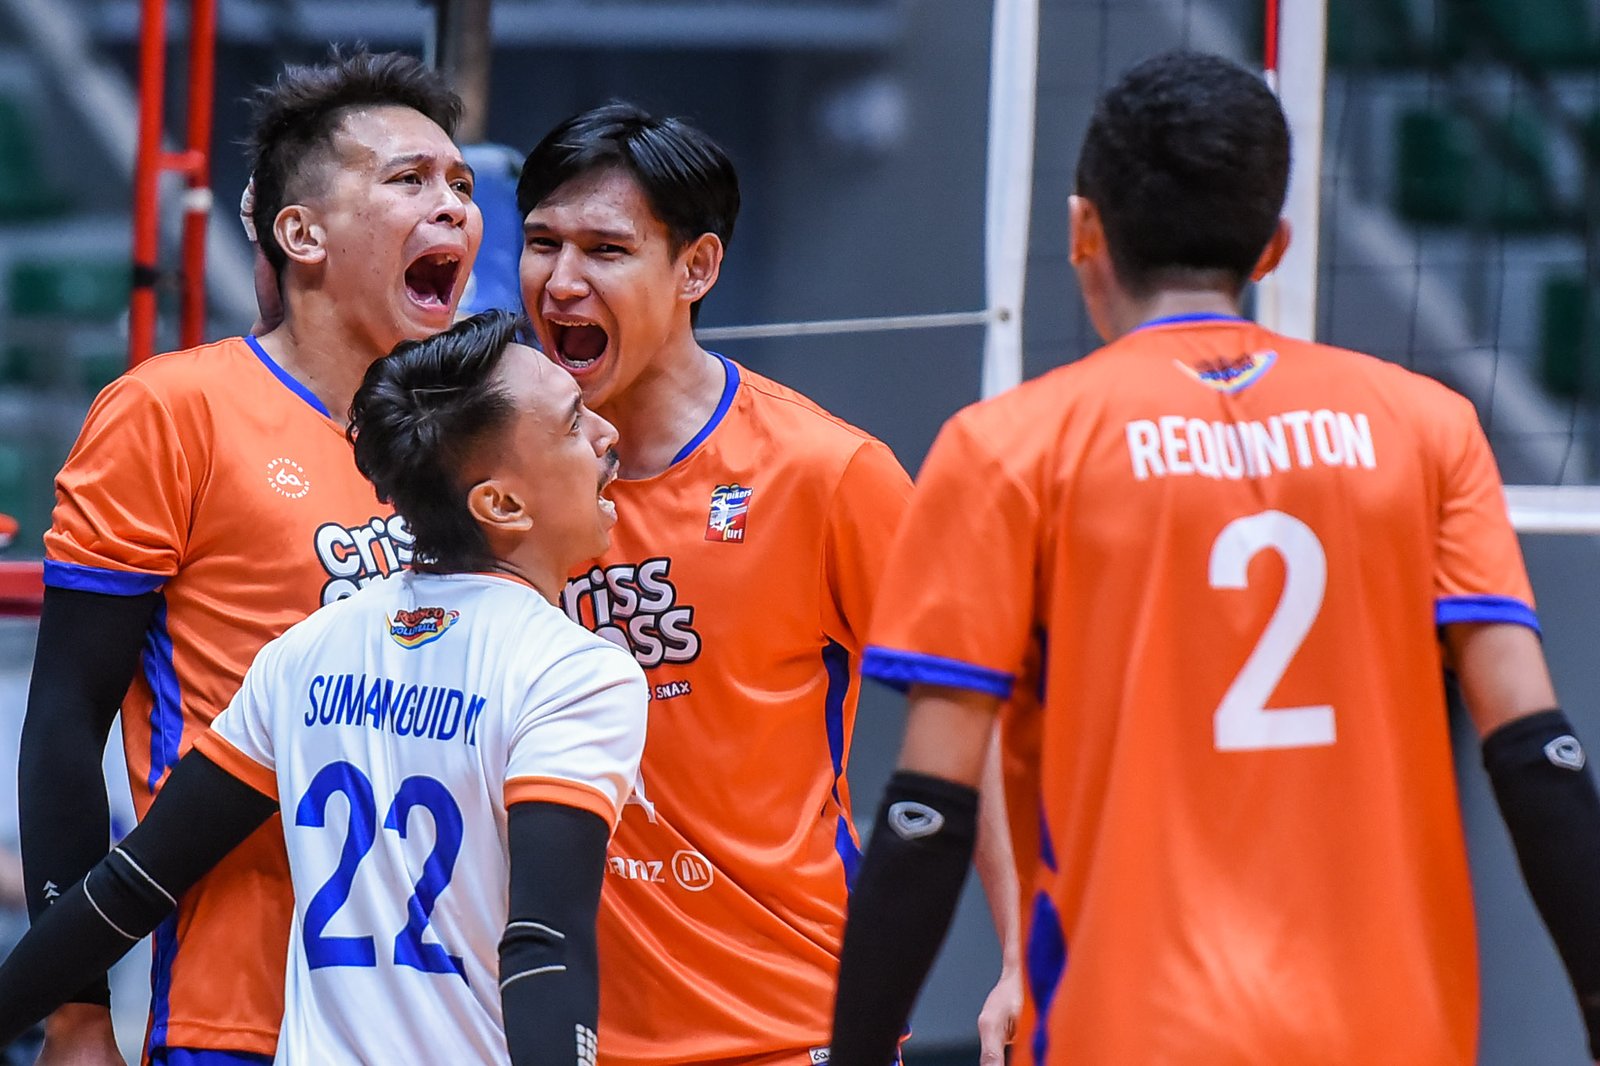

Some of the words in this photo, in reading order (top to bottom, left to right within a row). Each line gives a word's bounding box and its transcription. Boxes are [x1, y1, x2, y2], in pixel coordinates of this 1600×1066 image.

[1126, 408, 1377, 481] REQUINTON
[314, 514, 416, 578] Cris
[722, 520, 743, 541] Turf
[560, 557, 677, 630] riss
[1207, 509, 1337, 752] 2
[304, 673, 464, 741] SUMANGUID
[655, 681, 691, 700] SNAX
[295, 760, 470, 988] 22
